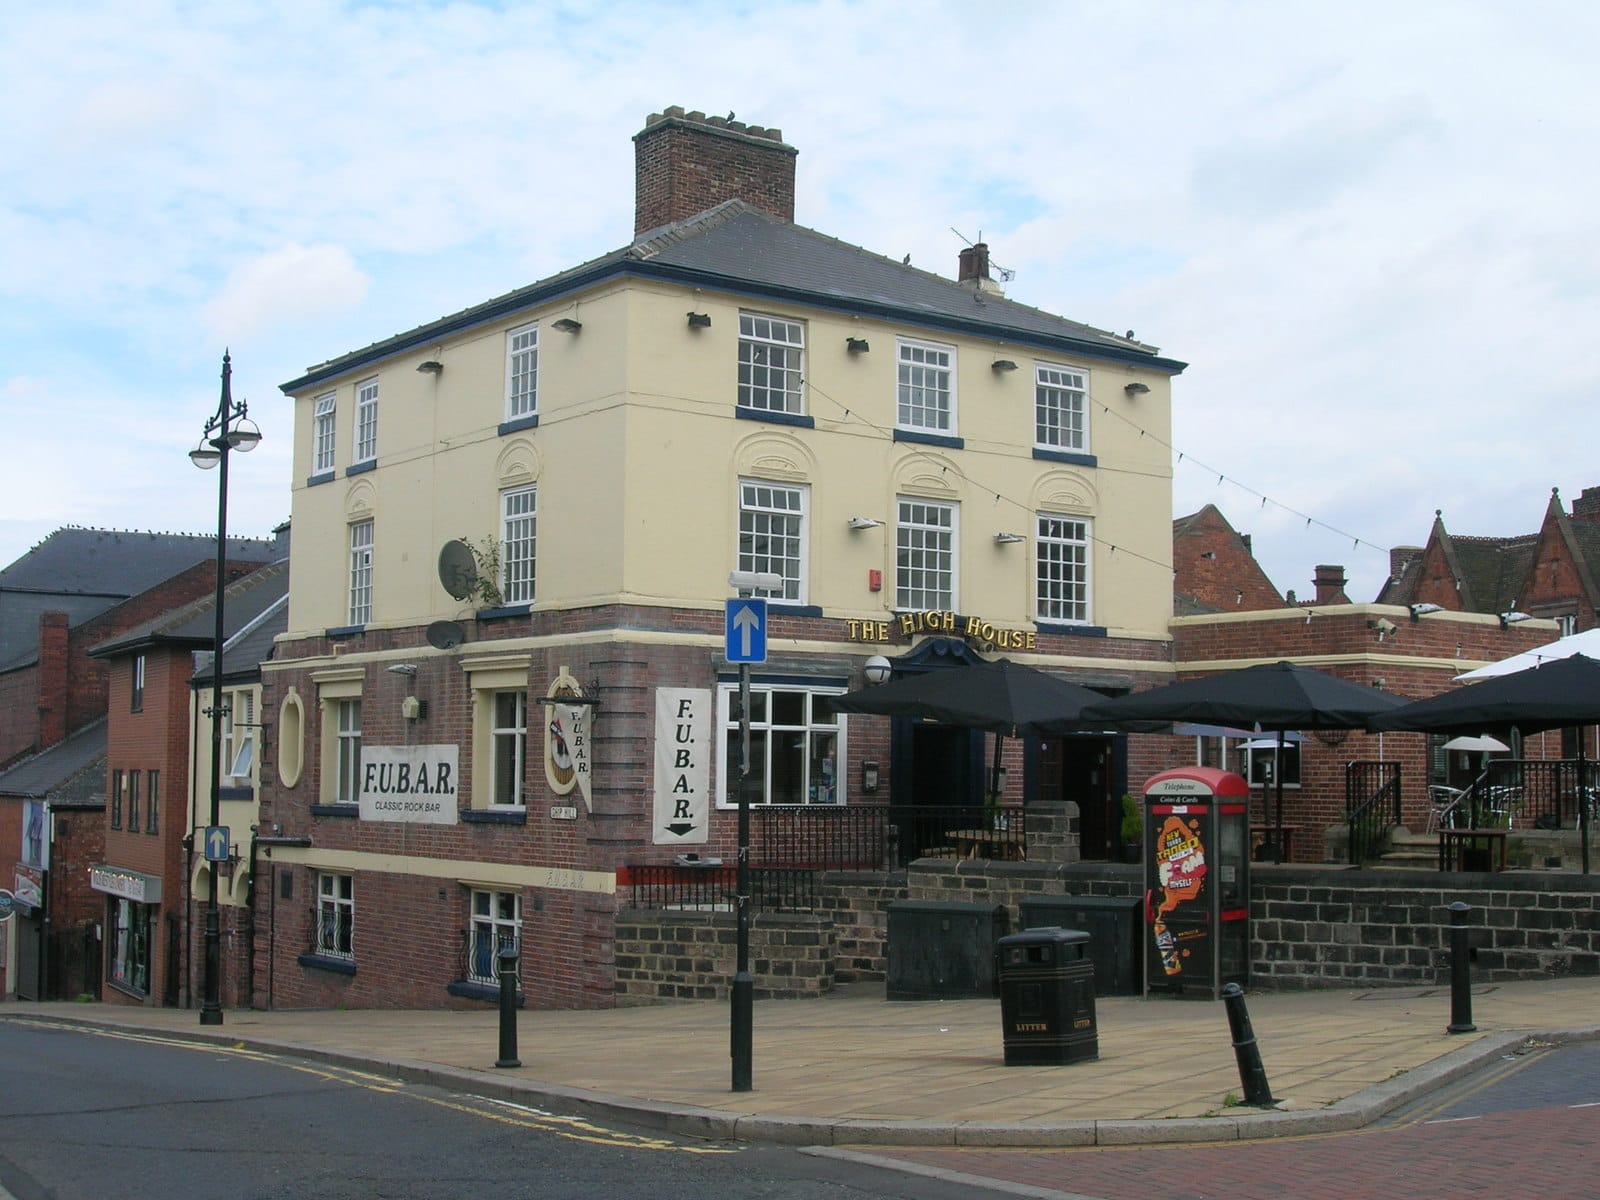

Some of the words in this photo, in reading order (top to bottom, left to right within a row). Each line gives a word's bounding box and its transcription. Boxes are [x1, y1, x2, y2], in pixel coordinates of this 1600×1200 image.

[847, 619, 889, 641] THE
[900, 610, 956, 636] HIGH
[966, 616, 1037, 650] HOUSE
[672, 699, 696, 819] F.U.B.A.R.
[363, 762, 455, 794] F.U.B.A.R.
[1163, 783, 1195, 791] Telephone
[375, 801, 403, 811] CLASSIC
[404, 802, 424, 812] ROCK
[425, 803, 441, 813] BAR
[1166, 829, 1180, 841] NEW
[1156, 837, 1199, 861] TANGO
[1016, 1023, 1047, 1032] LITTER
